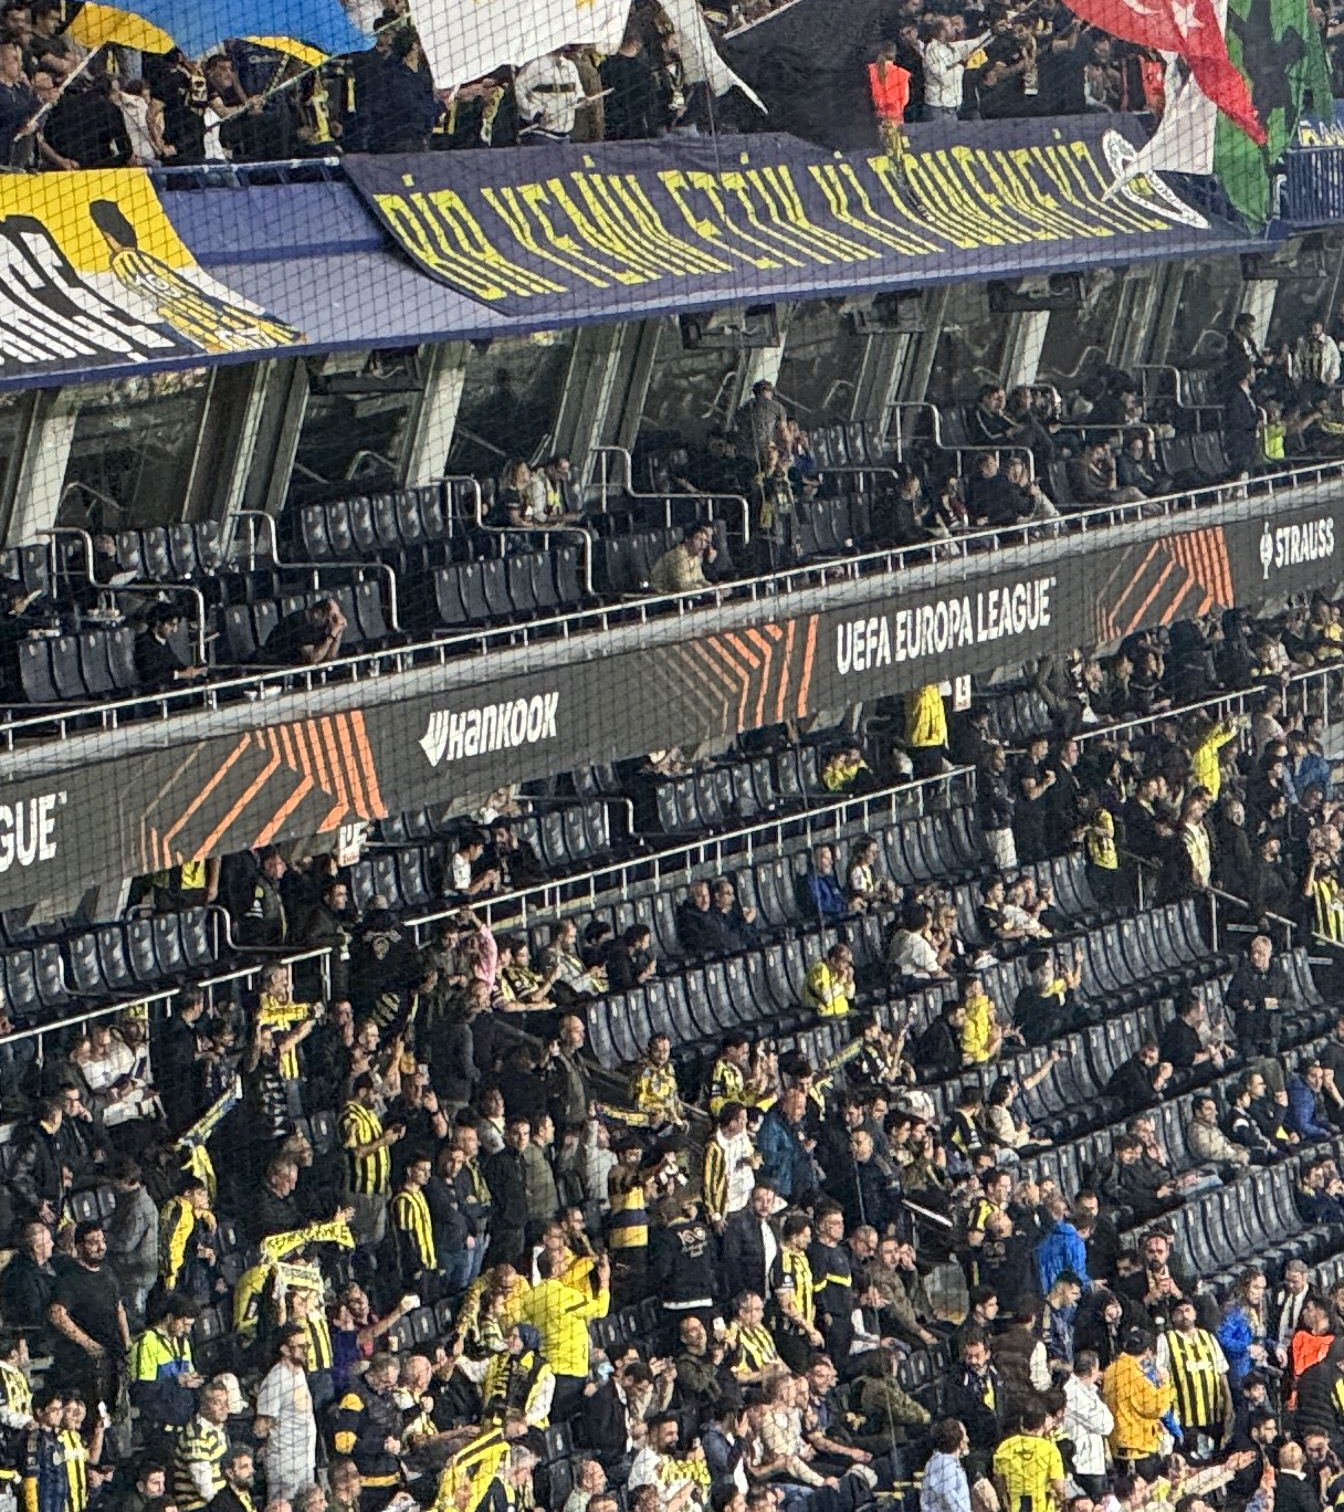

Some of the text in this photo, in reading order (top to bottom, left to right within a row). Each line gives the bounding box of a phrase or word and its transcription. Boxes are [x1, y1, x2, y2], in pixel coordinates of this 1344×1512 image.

[373, 173, 568, 301] BİR
[481, 154, 736, 288] YEMİN
[1275, 516, 1335, 568] STRAUSS
[837, 616, 891, 675] UEFA
[895, 595, 974, 662] EUROPA
